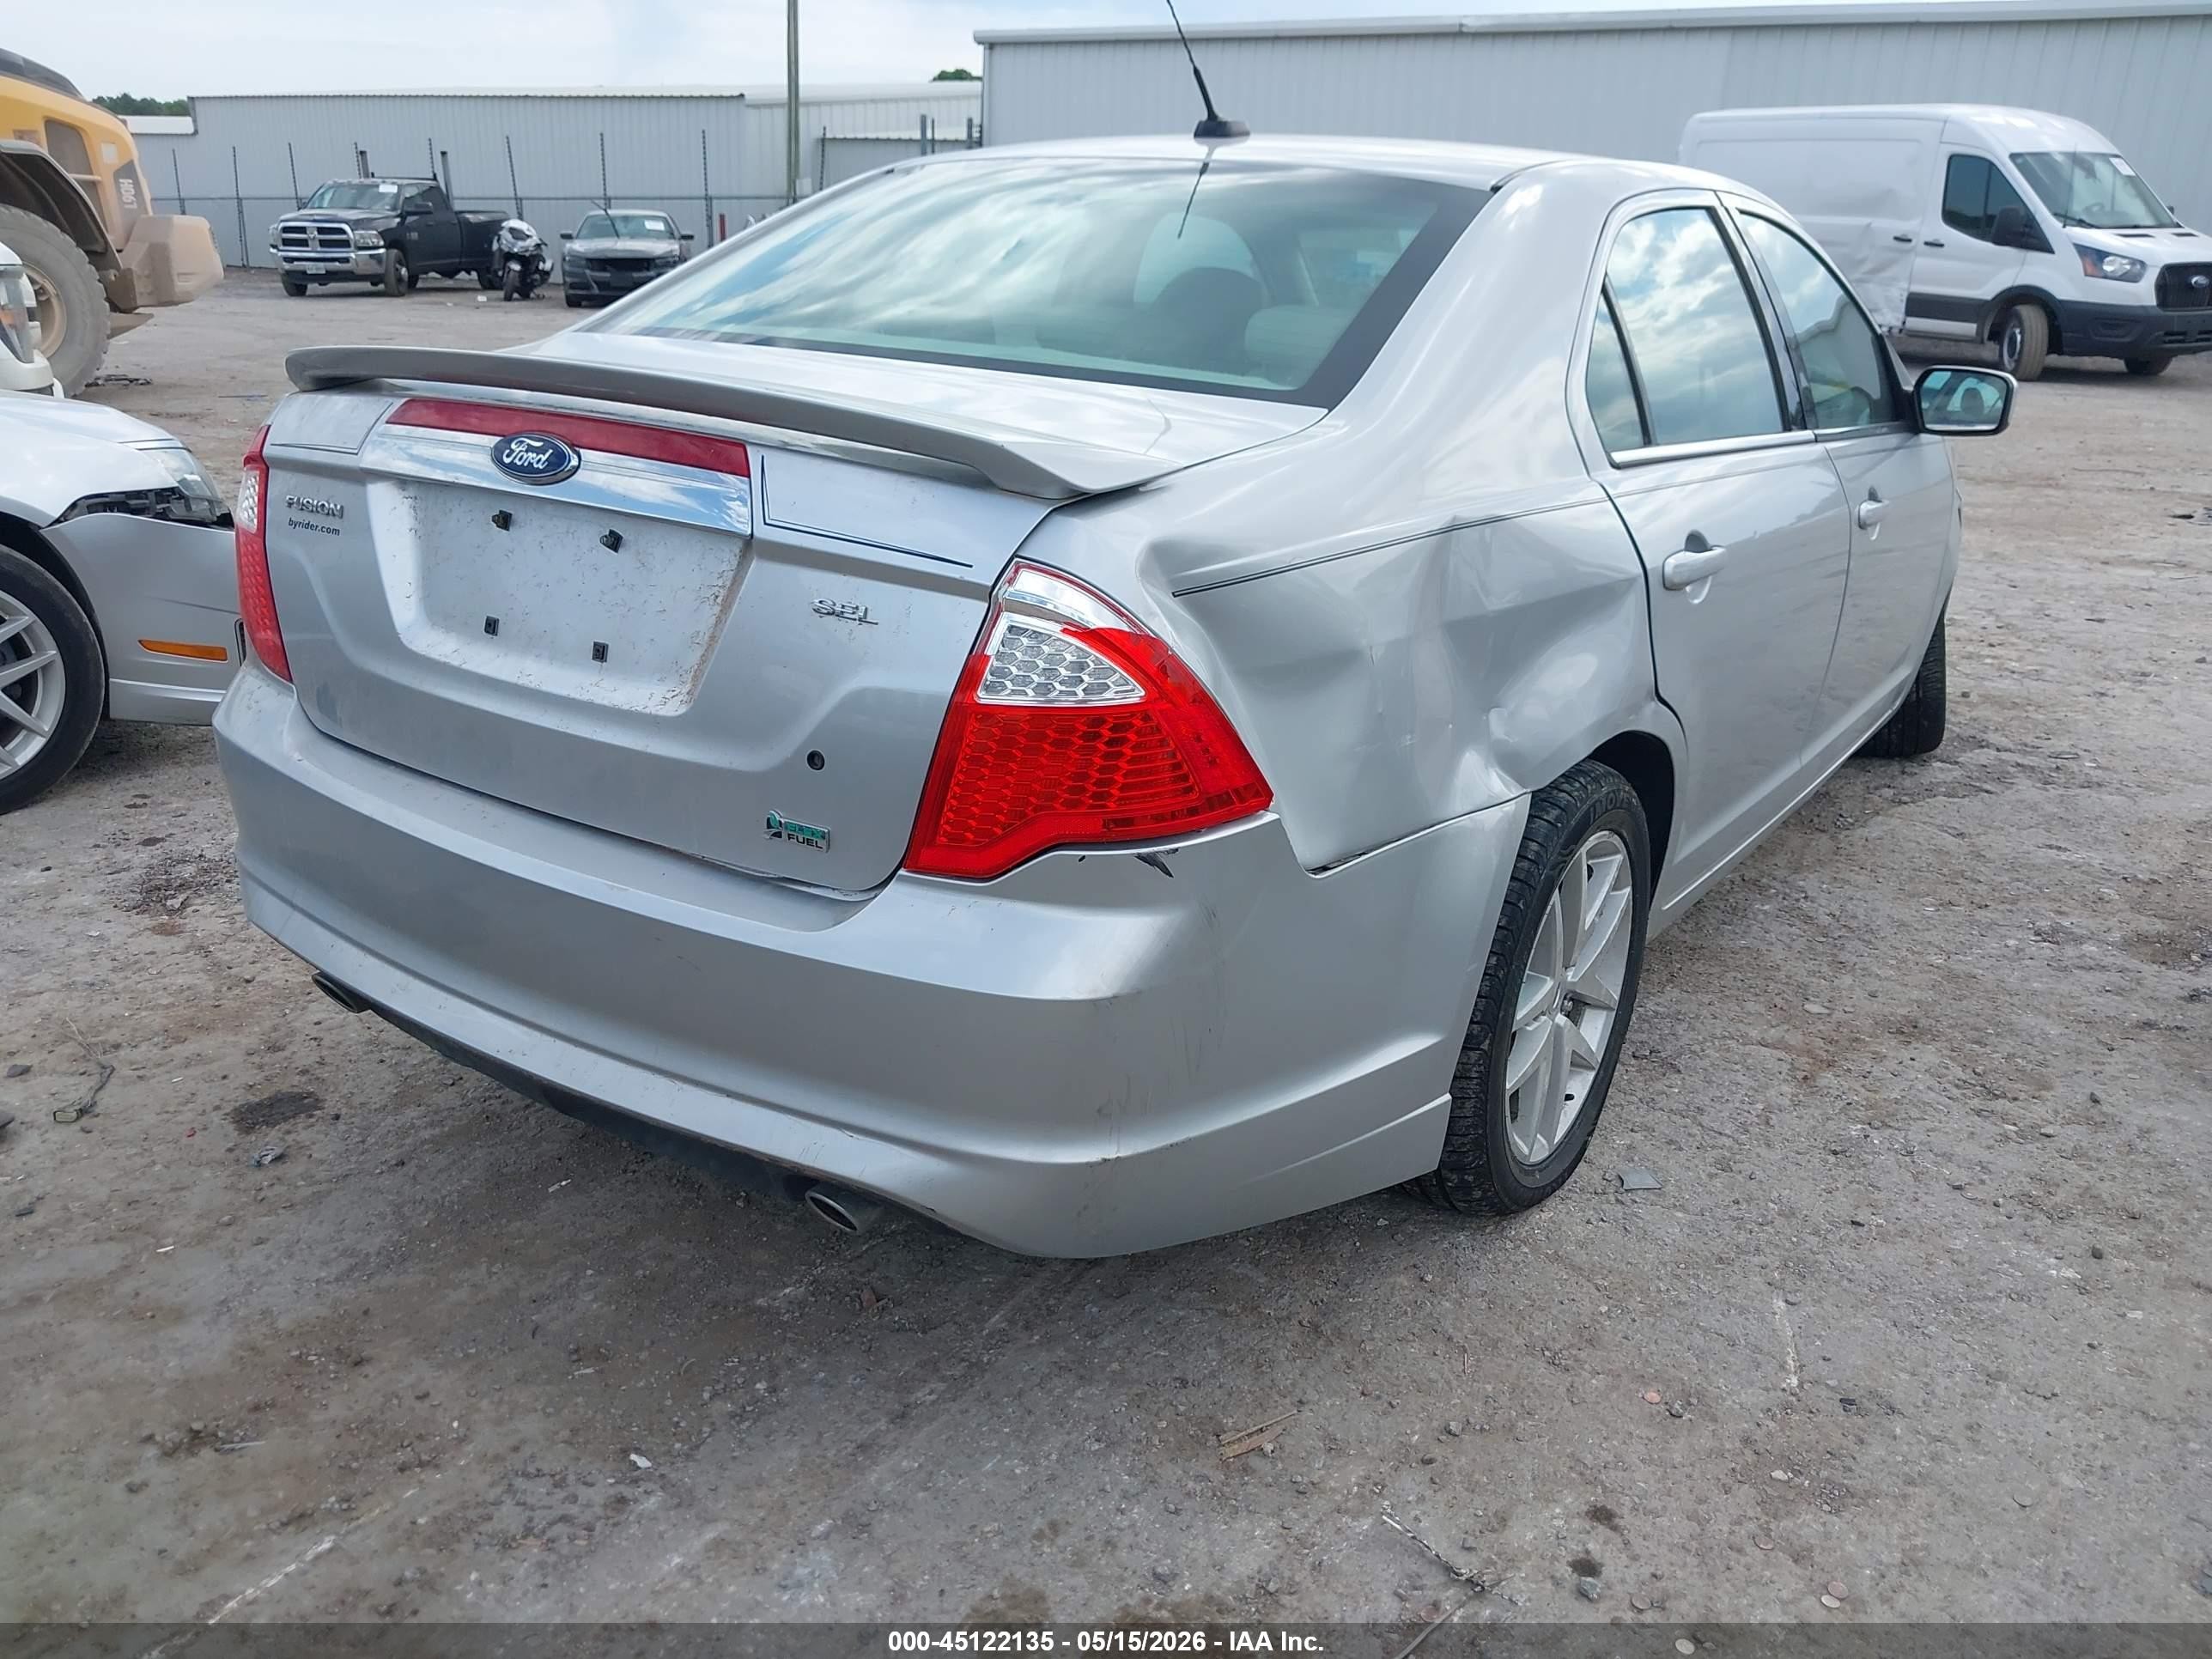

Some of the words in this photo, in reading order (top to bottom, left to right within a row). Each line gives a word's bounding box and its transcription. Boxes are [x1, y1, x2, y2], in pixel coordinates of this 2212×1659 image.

[502, 437, 554, 470] Ford
[285, 495, 344, 519] FUSION
[288, 517, 341, 537] byrider.com
[810, 598, 878, 626] SEL
[787, 833, 823, 850] FUEL
